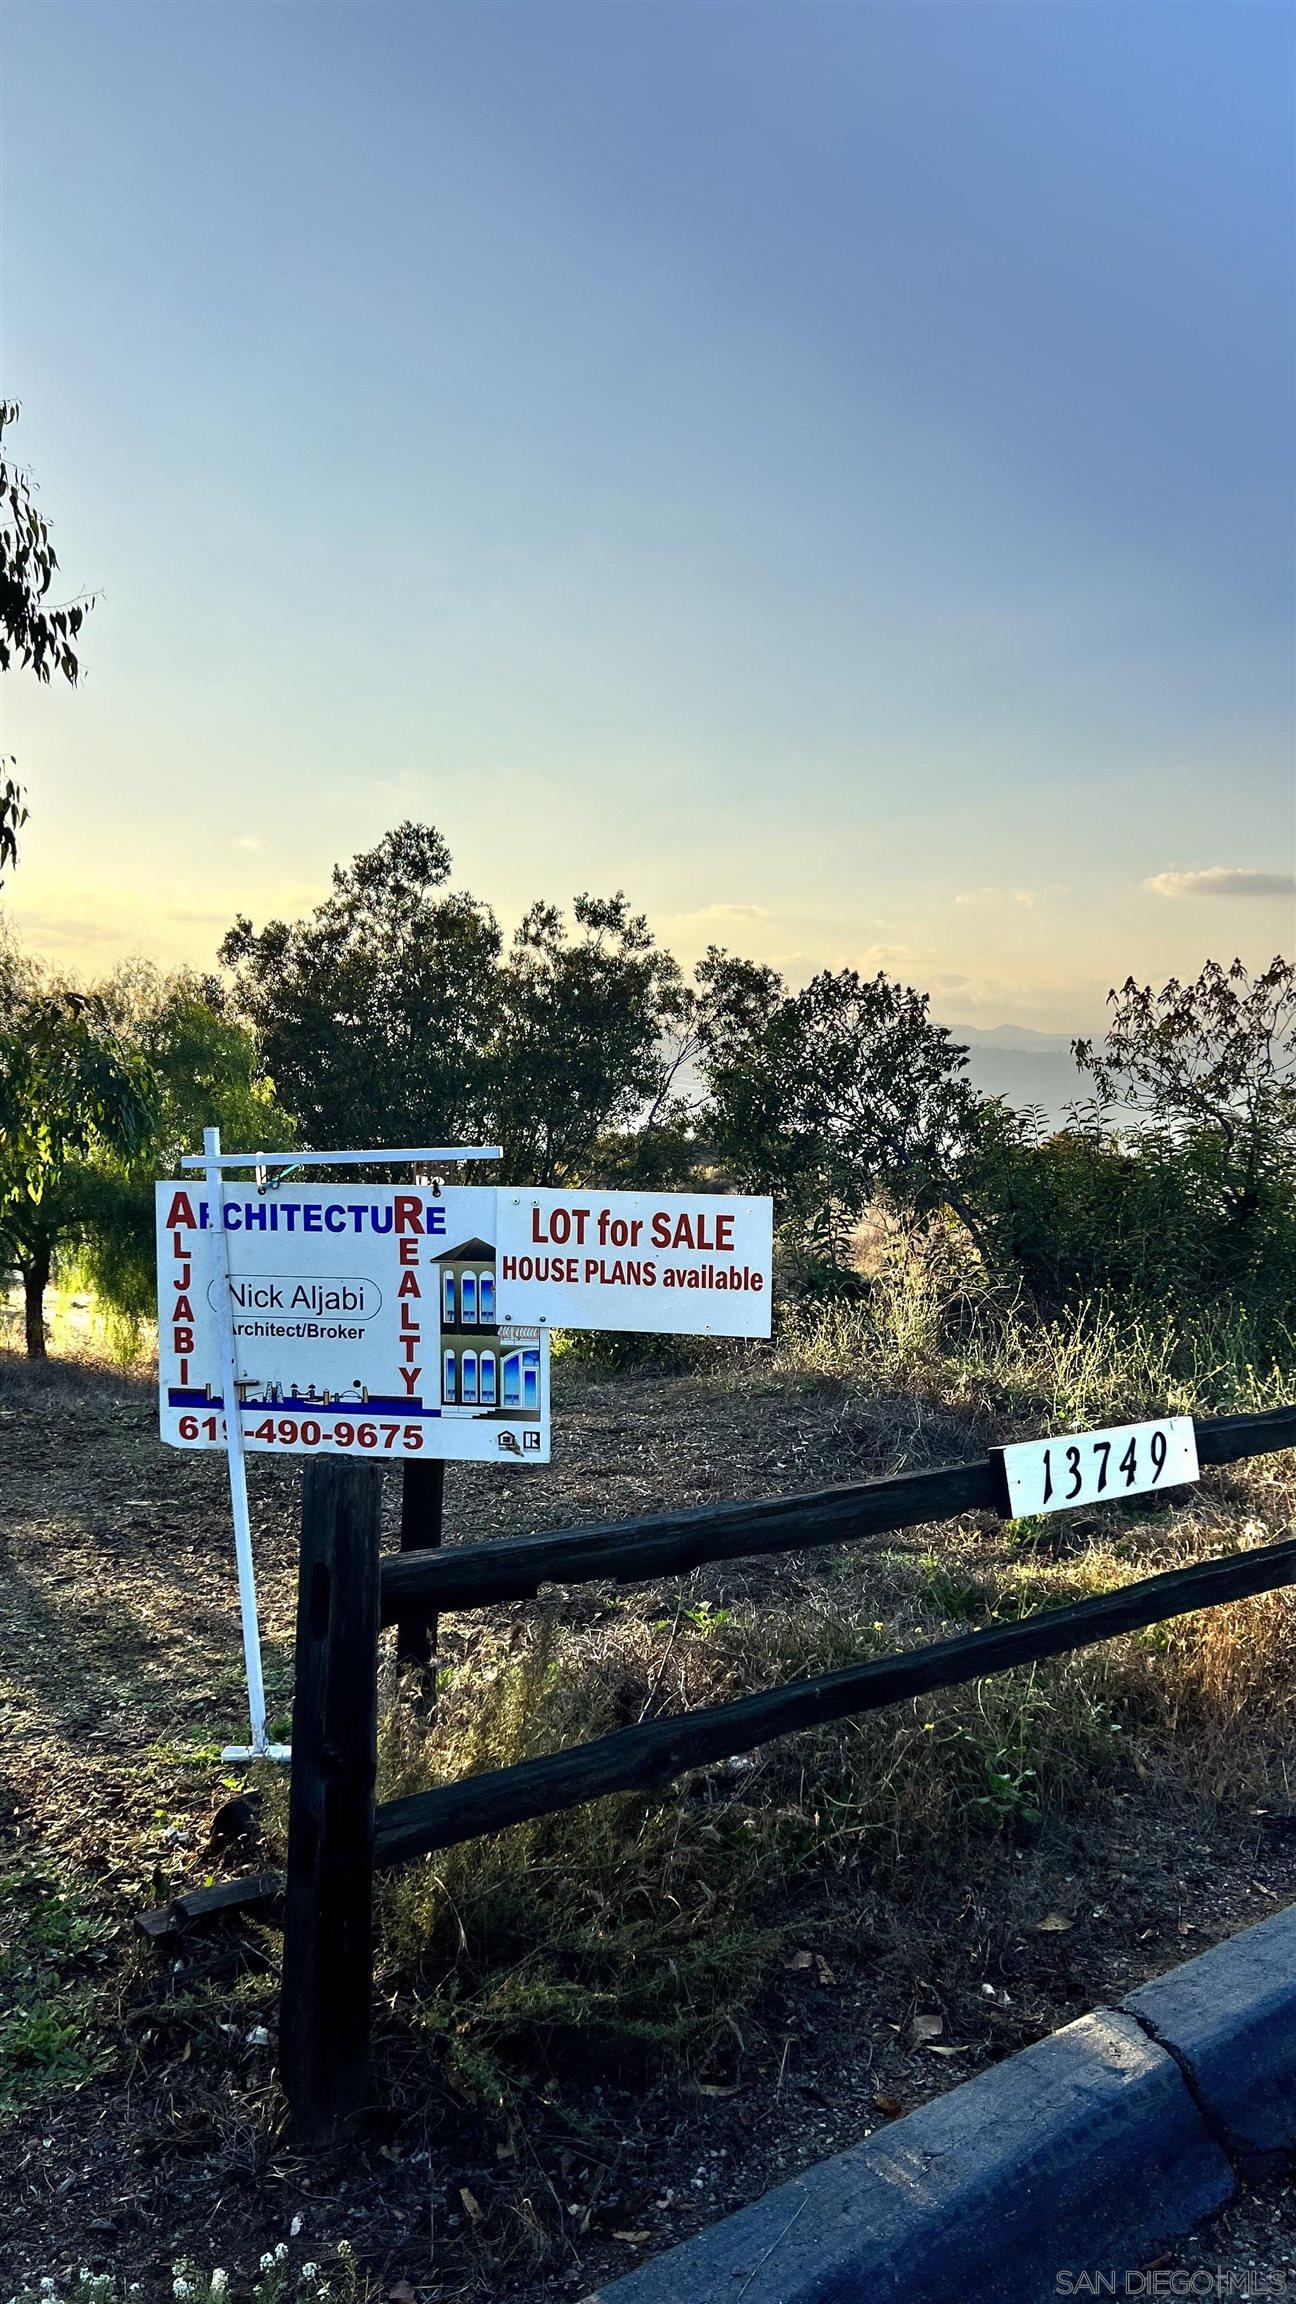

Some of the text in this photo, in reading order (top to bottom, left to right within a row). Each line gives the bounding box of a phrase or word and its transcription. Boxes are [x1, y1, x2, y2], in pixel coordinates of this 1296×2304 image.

[532, 1207, 735, 1251] LOT for SALE
[502, 1256, 763, 1291] HOUSE PLANS available
[291, 1285, 364, 1316] Aljabi
[178, 1415, 424, 1450] 61-490-9675
[1043, 1431, 1167, 1504] 13749
